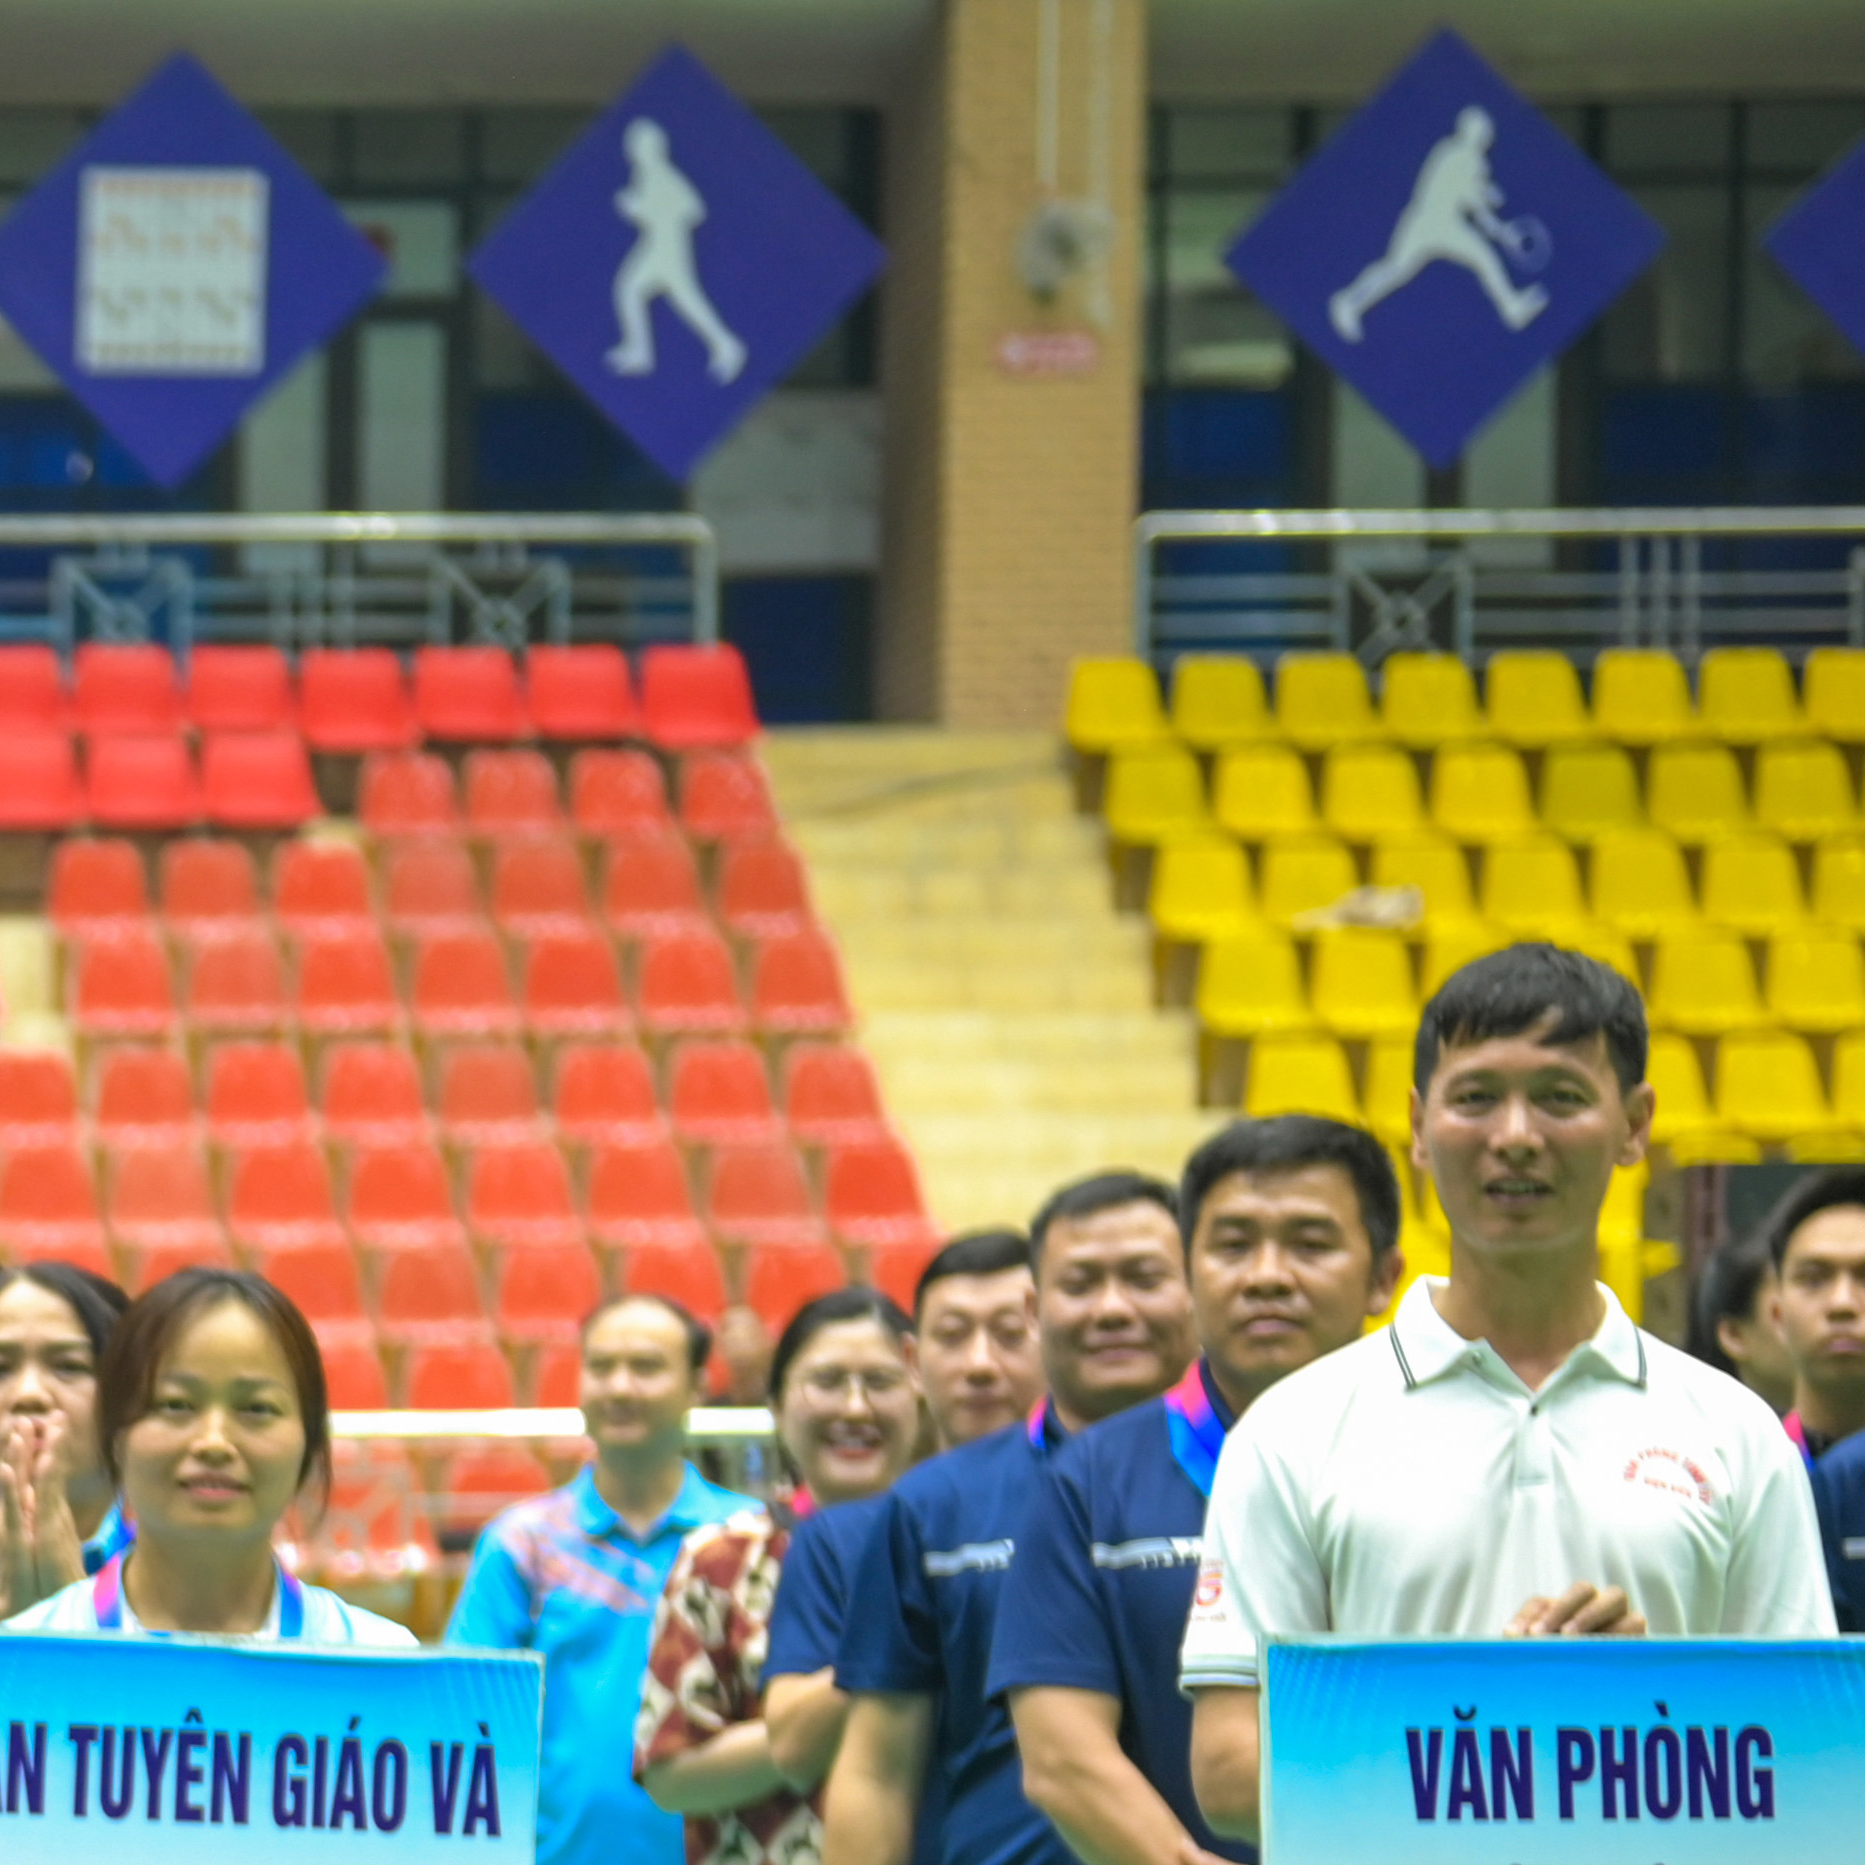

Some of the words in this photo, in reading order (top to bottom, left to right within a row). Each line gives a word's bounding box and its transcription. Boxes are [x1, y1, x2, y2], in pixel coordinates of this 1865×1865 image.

[69, 1707, 252, 1825] TUYÊN
[272, 1717, 407, 1833] GIÁO
[430, 1722, 501, 1837] VÀ
[1405, 1704, 1535, 1821] VĂN
[1556, 1700, 1775, 1820] PHÒNG
